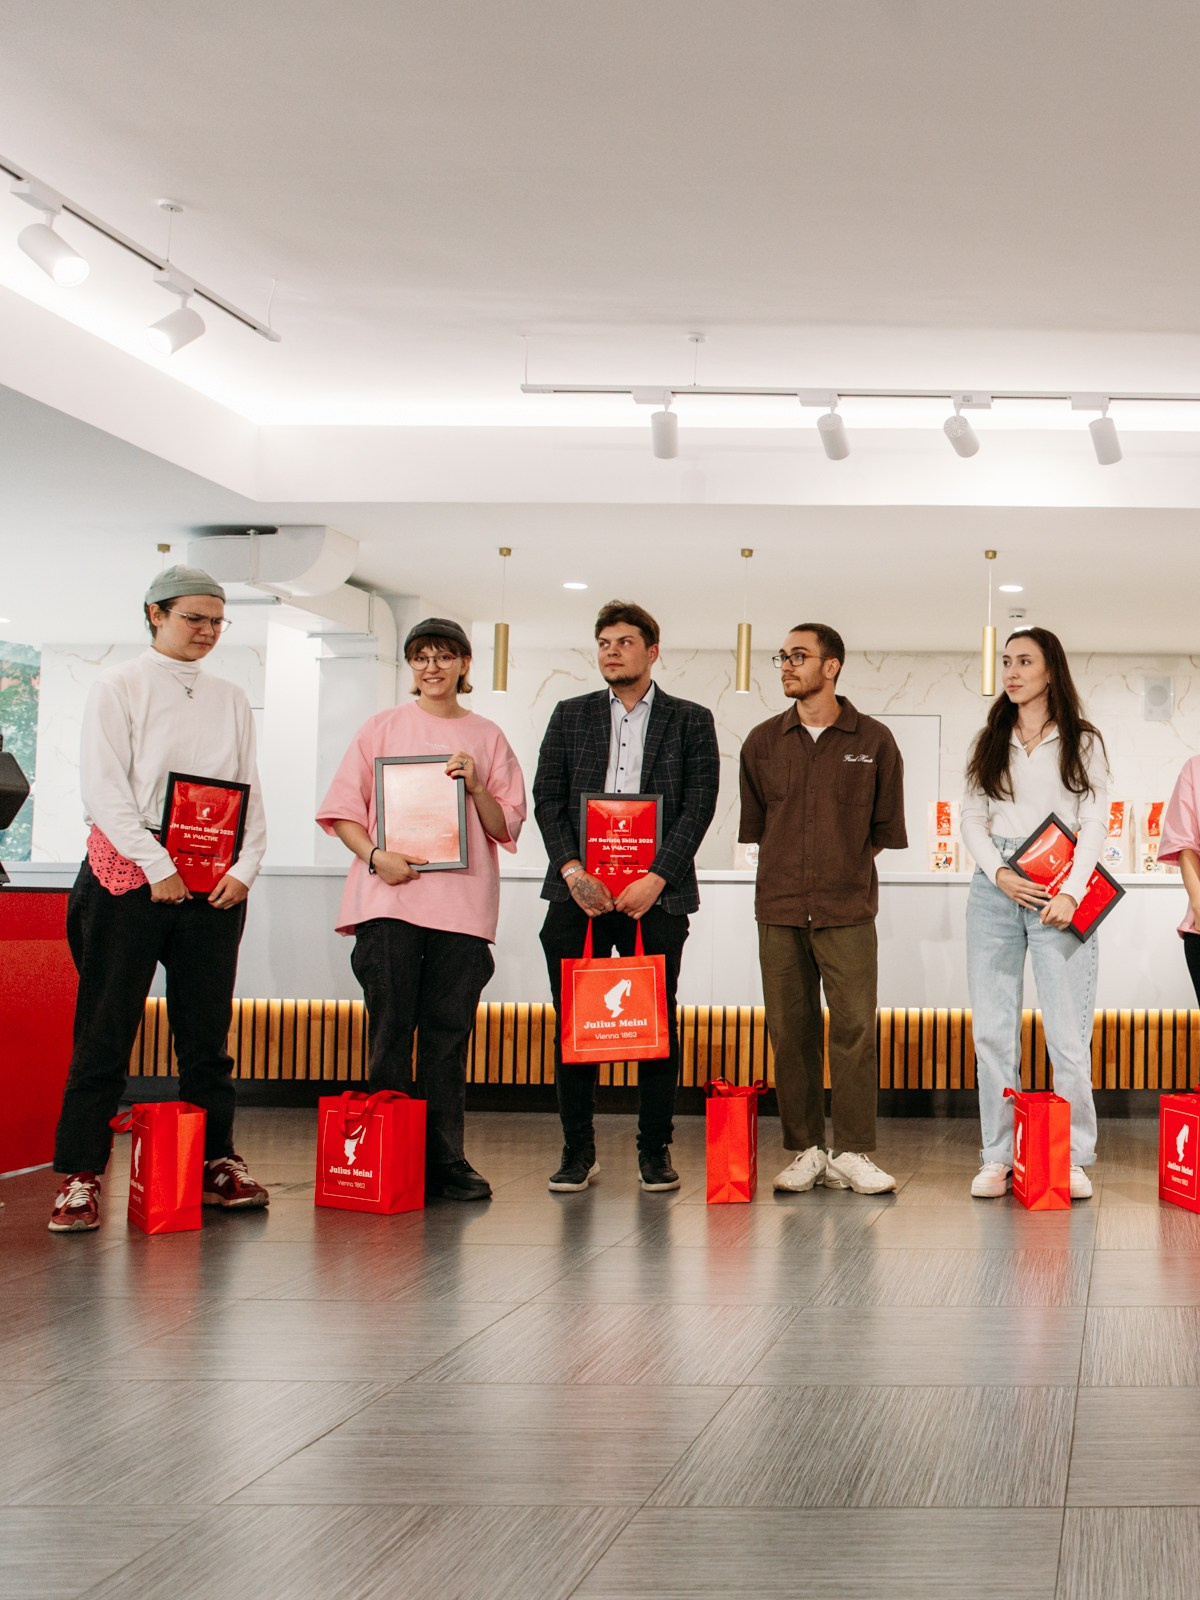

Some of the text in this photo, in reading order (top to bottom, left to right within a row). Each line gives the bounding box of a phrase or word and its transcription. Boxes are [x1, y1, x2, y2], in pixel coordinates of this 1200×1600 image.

[180, 824, 202, 832] Barista
[193, 834, 218, 842] УЧАСТИЕ
[584, 1018, 647, 1029] Julius Meinl
[621, 1031, 637, 1039] 1862
[329, 1166, 373, 1178] Julius Meinl
